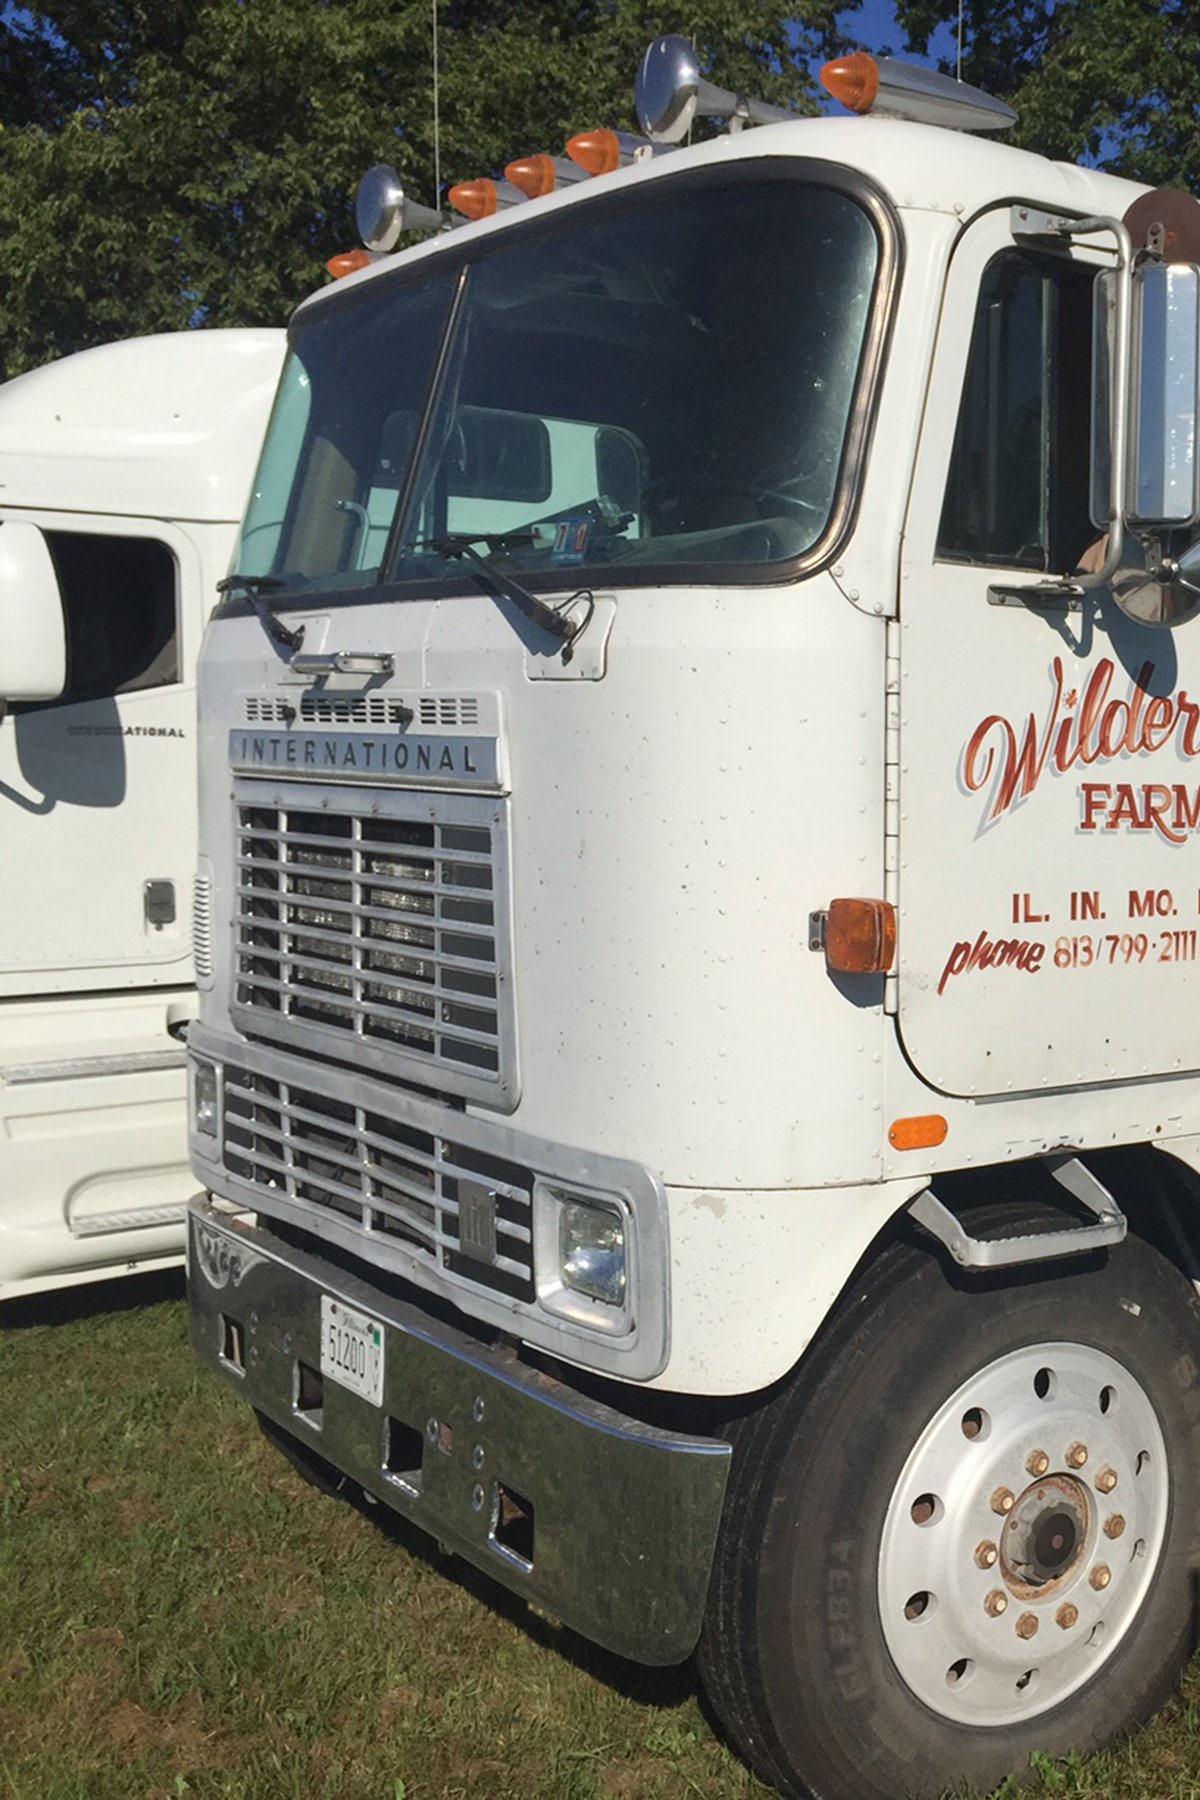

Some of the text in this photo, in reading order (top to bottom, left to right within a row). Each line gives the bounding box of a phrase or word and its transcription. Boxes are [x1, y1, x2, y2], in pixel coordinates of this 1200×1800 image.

[67, 724, 186, 739] TATIONAL
[241, 737, 477, 773] INTERNATIONAL
[1070, 890, 1106, 920] IN.
[1128, 889, 1178, 918] MO.
[937, 930, 1046, 996] phone
